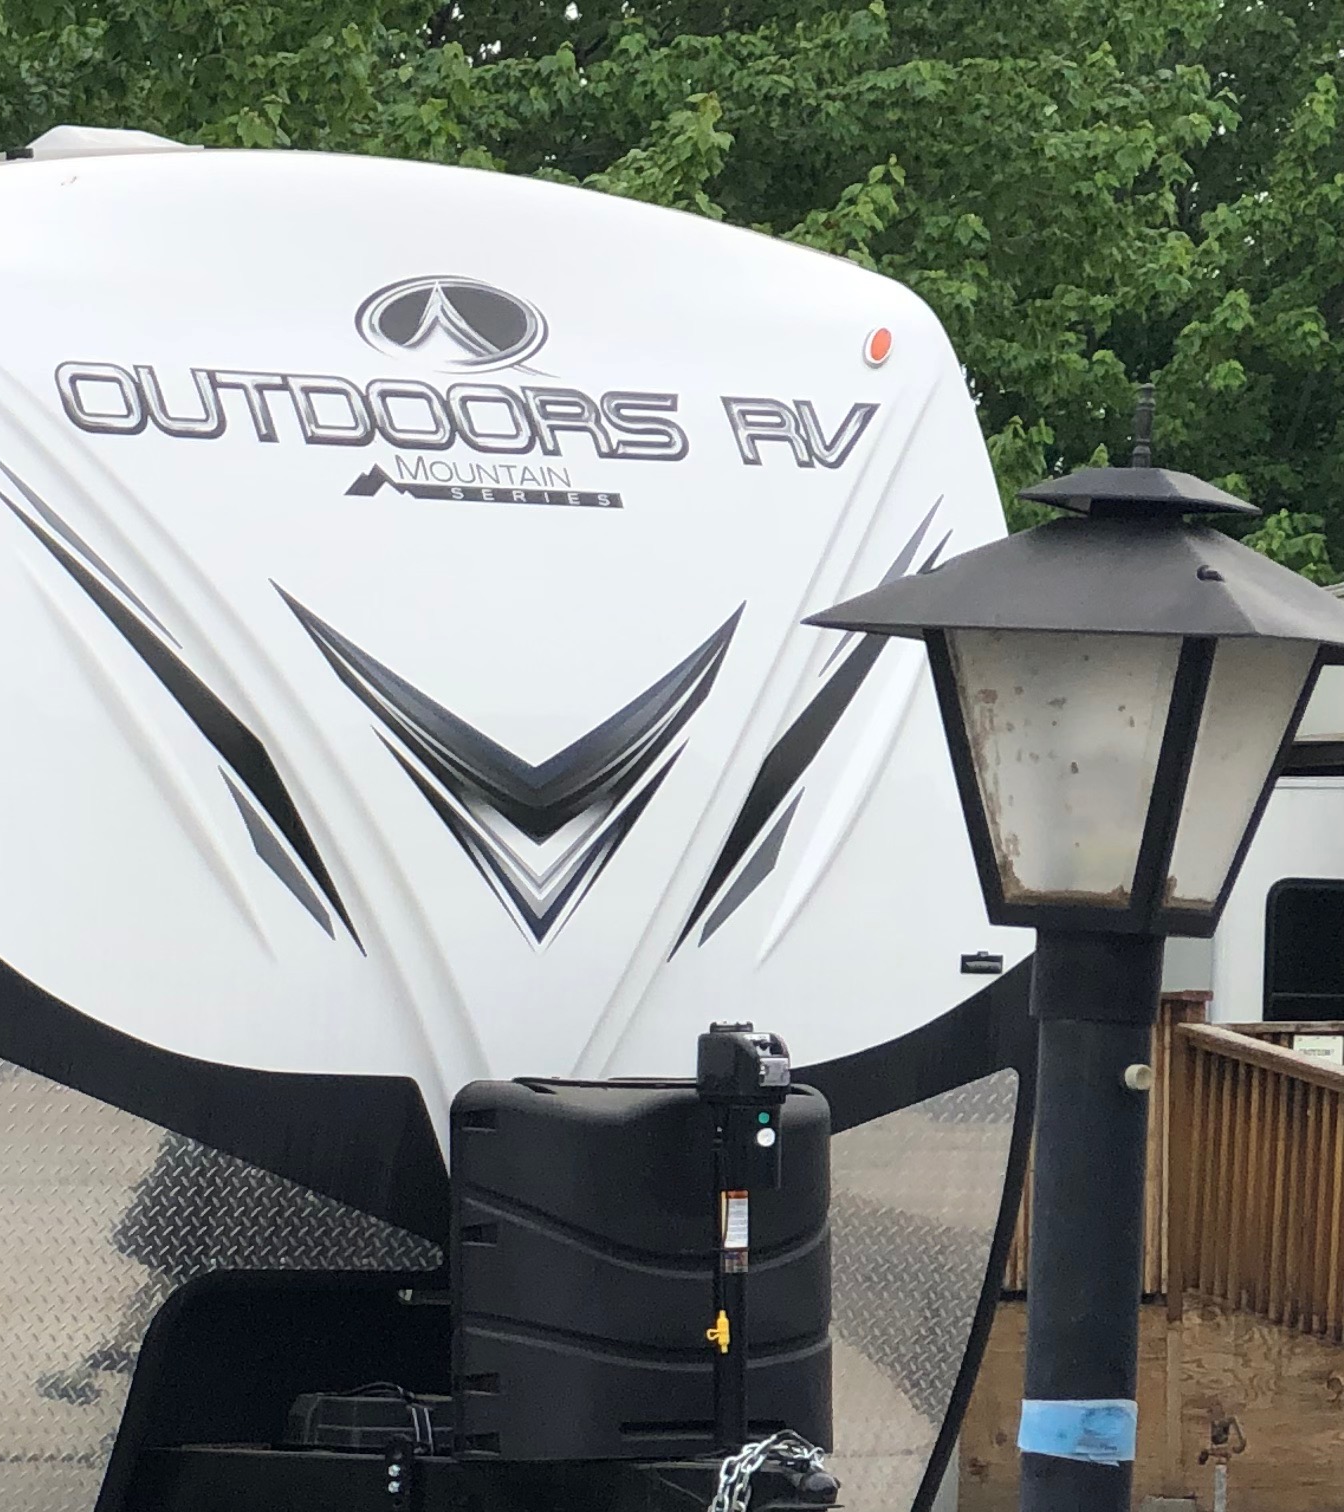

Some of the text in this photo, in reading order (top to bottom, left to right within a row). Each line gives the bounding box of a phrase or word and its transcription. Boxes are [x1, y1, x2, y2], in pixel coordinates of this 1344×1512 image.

[55, 360, 882, 469] OUTDOORS RV
[394, 454, 572, 488] MOUNTAIN
[450, 486, 612, 507] SERIES
